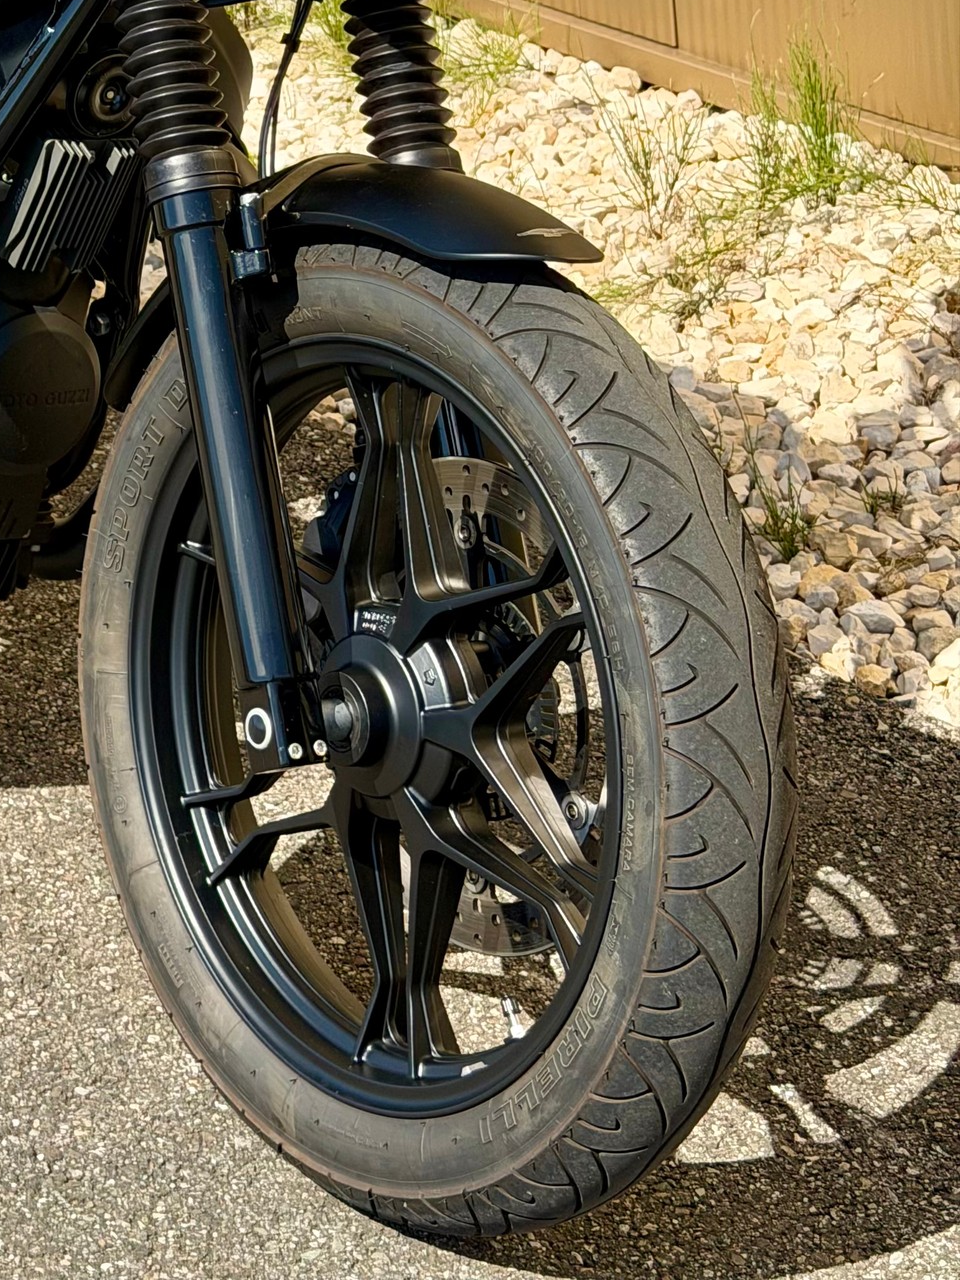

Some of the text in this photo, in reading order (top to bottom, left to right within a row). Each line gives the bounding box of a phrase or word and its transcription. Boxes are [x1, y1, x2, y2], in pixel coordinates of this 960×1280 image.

[44, 387, 90, 407] GUZZI
[102, 415, 165, 574] SPORT
[478, 972, 608, 1144] PIRELLI
